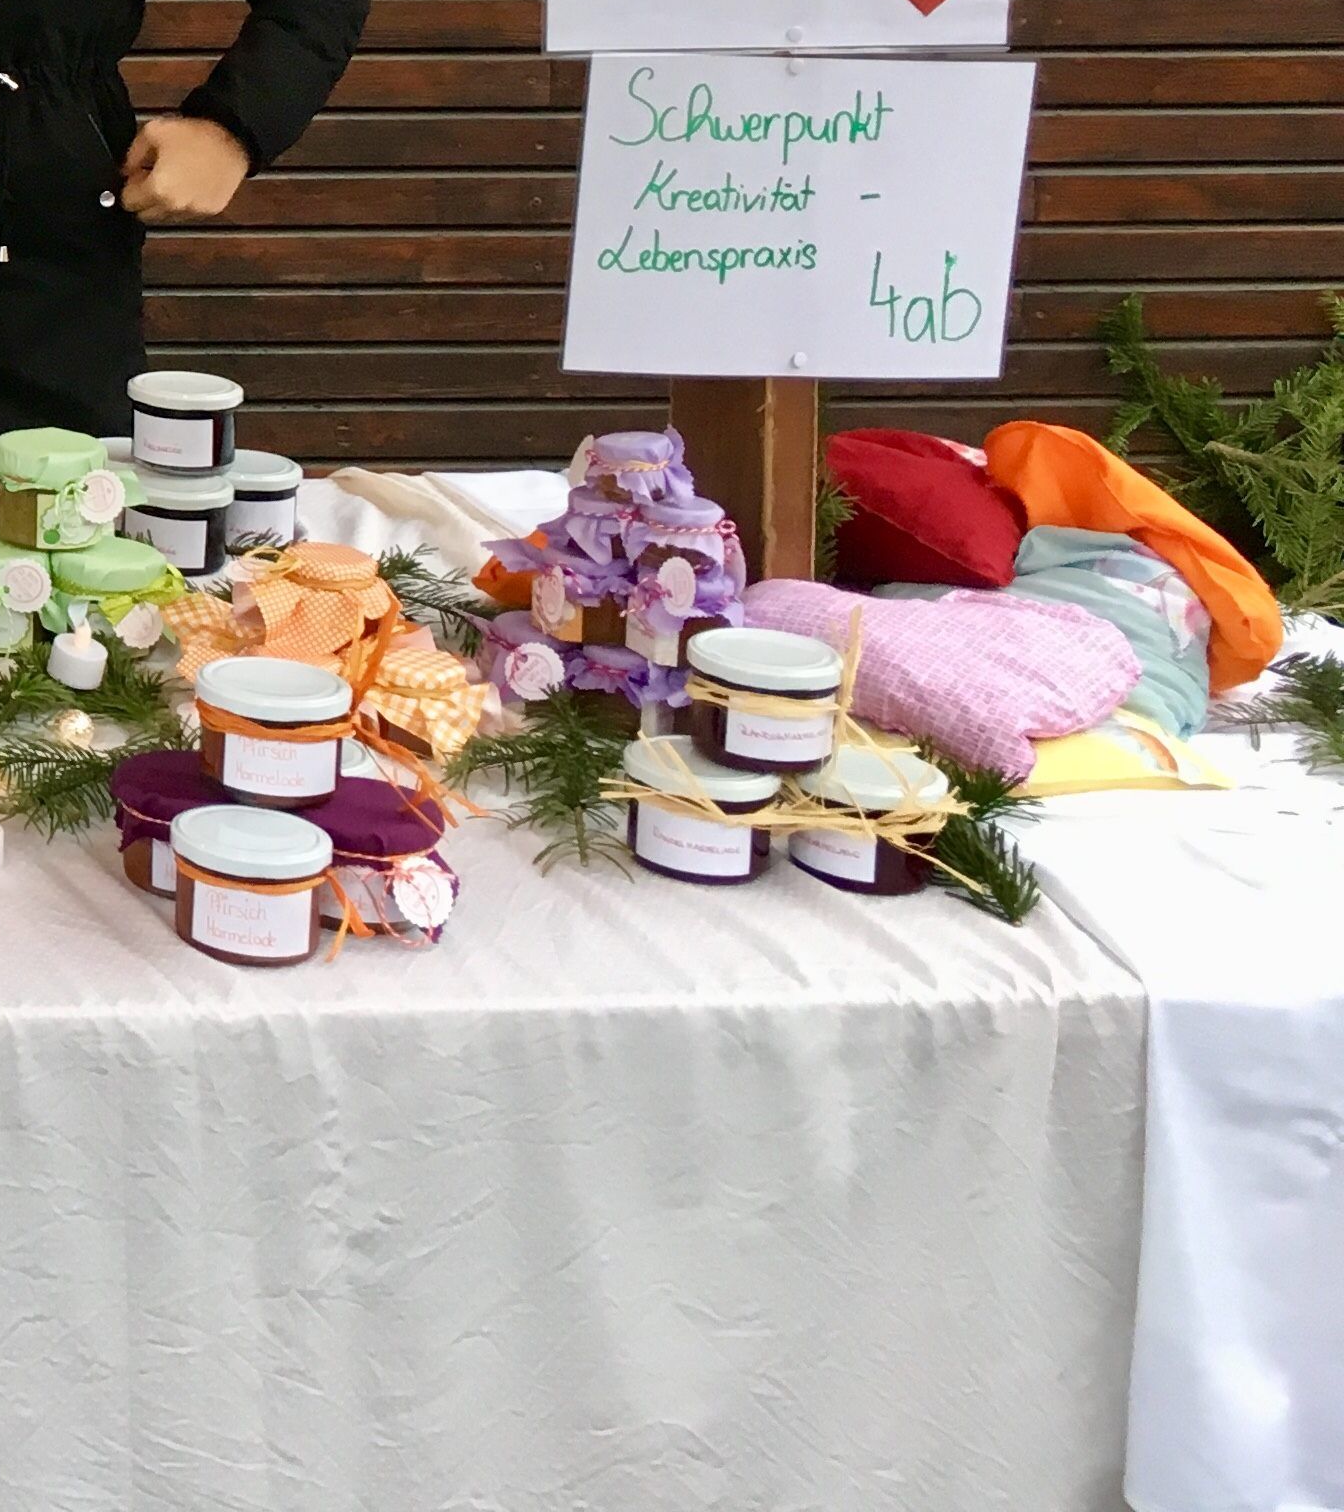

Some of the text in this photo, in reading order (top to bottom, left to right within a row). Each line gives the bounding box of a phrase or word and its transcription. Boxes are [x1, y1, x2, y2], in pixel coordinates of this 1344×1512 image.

[609, 66, 894, 166] Schwerpunkt
[633, 161, 815, 212] Kreativität
[598, 225, 818, 284] Lebenspraxis
[870, 251, 982, 344] 4ab
[206, 889, 267, 921] Pfirsich
